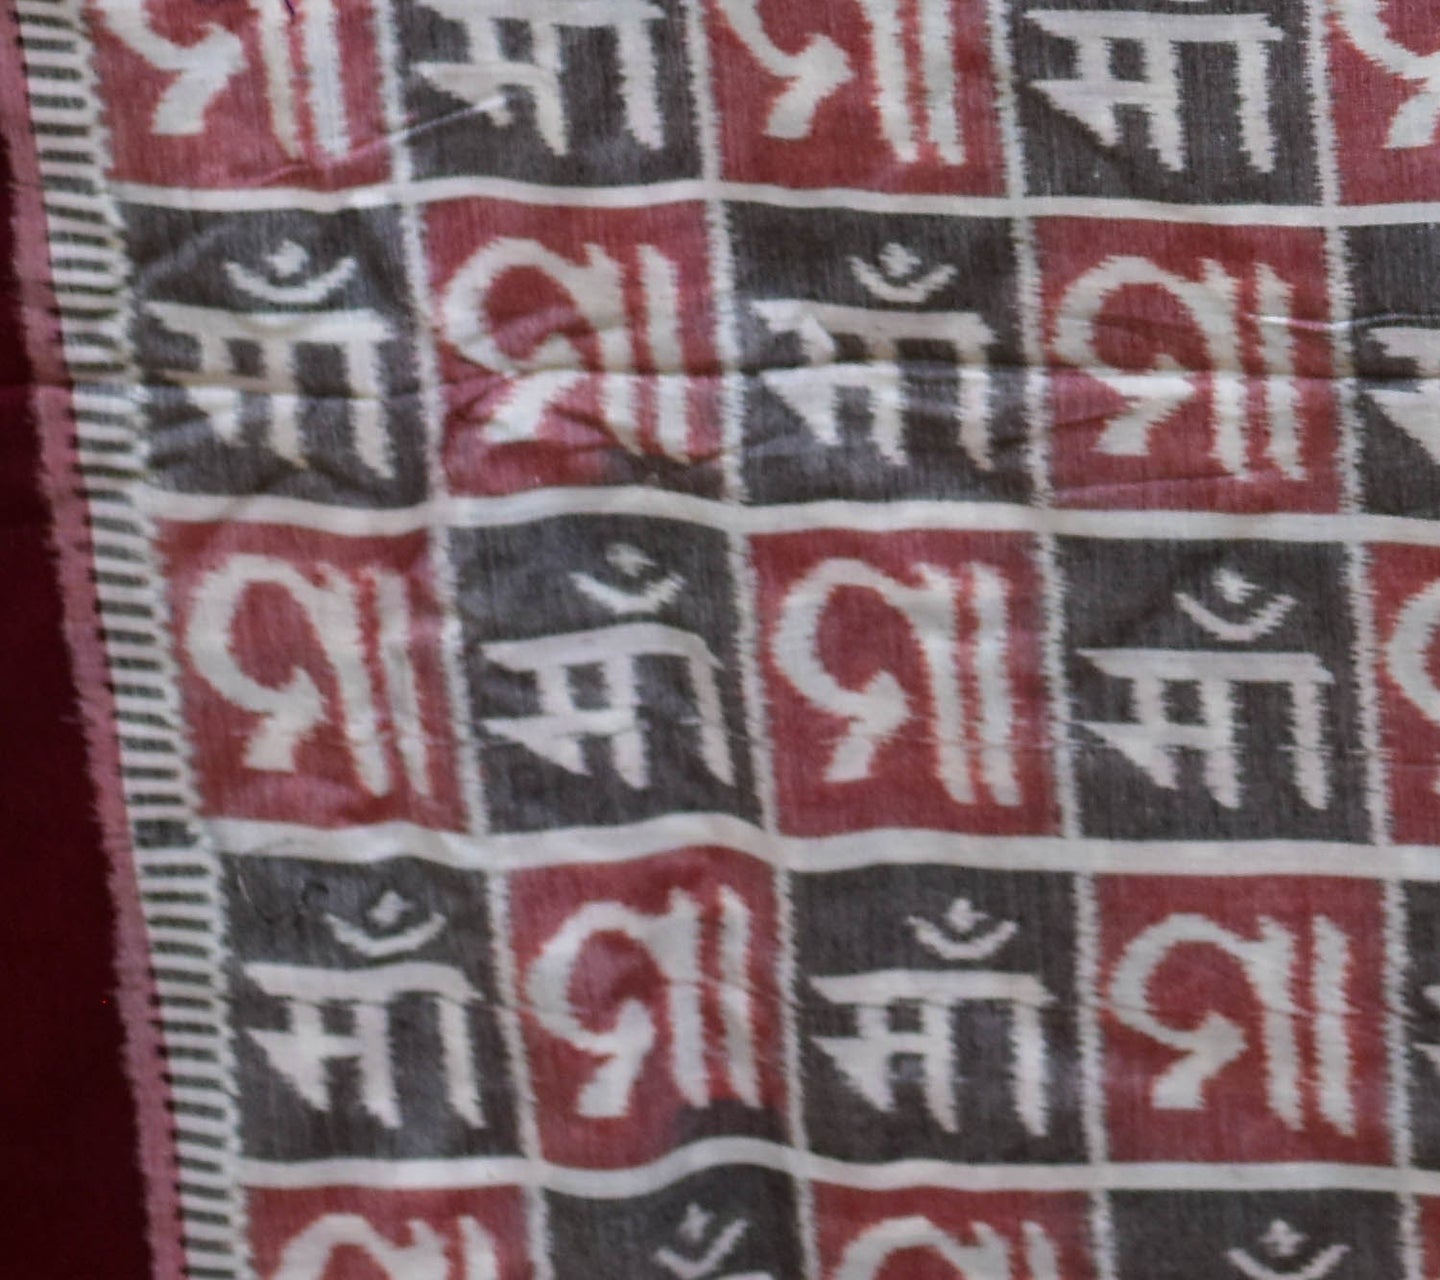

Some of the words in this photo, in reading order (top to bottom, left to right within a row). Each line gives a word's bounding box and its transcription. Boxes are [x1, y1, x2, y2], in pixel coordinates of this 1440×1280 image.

[142, 241, 393, 477] माँ
[483, 547, 732, 787] माँ
[1085, 569, 1332, 808] माँ
[243, 888, 487, 1130] माँ
[814, 899, 1051, 1135] माँ
